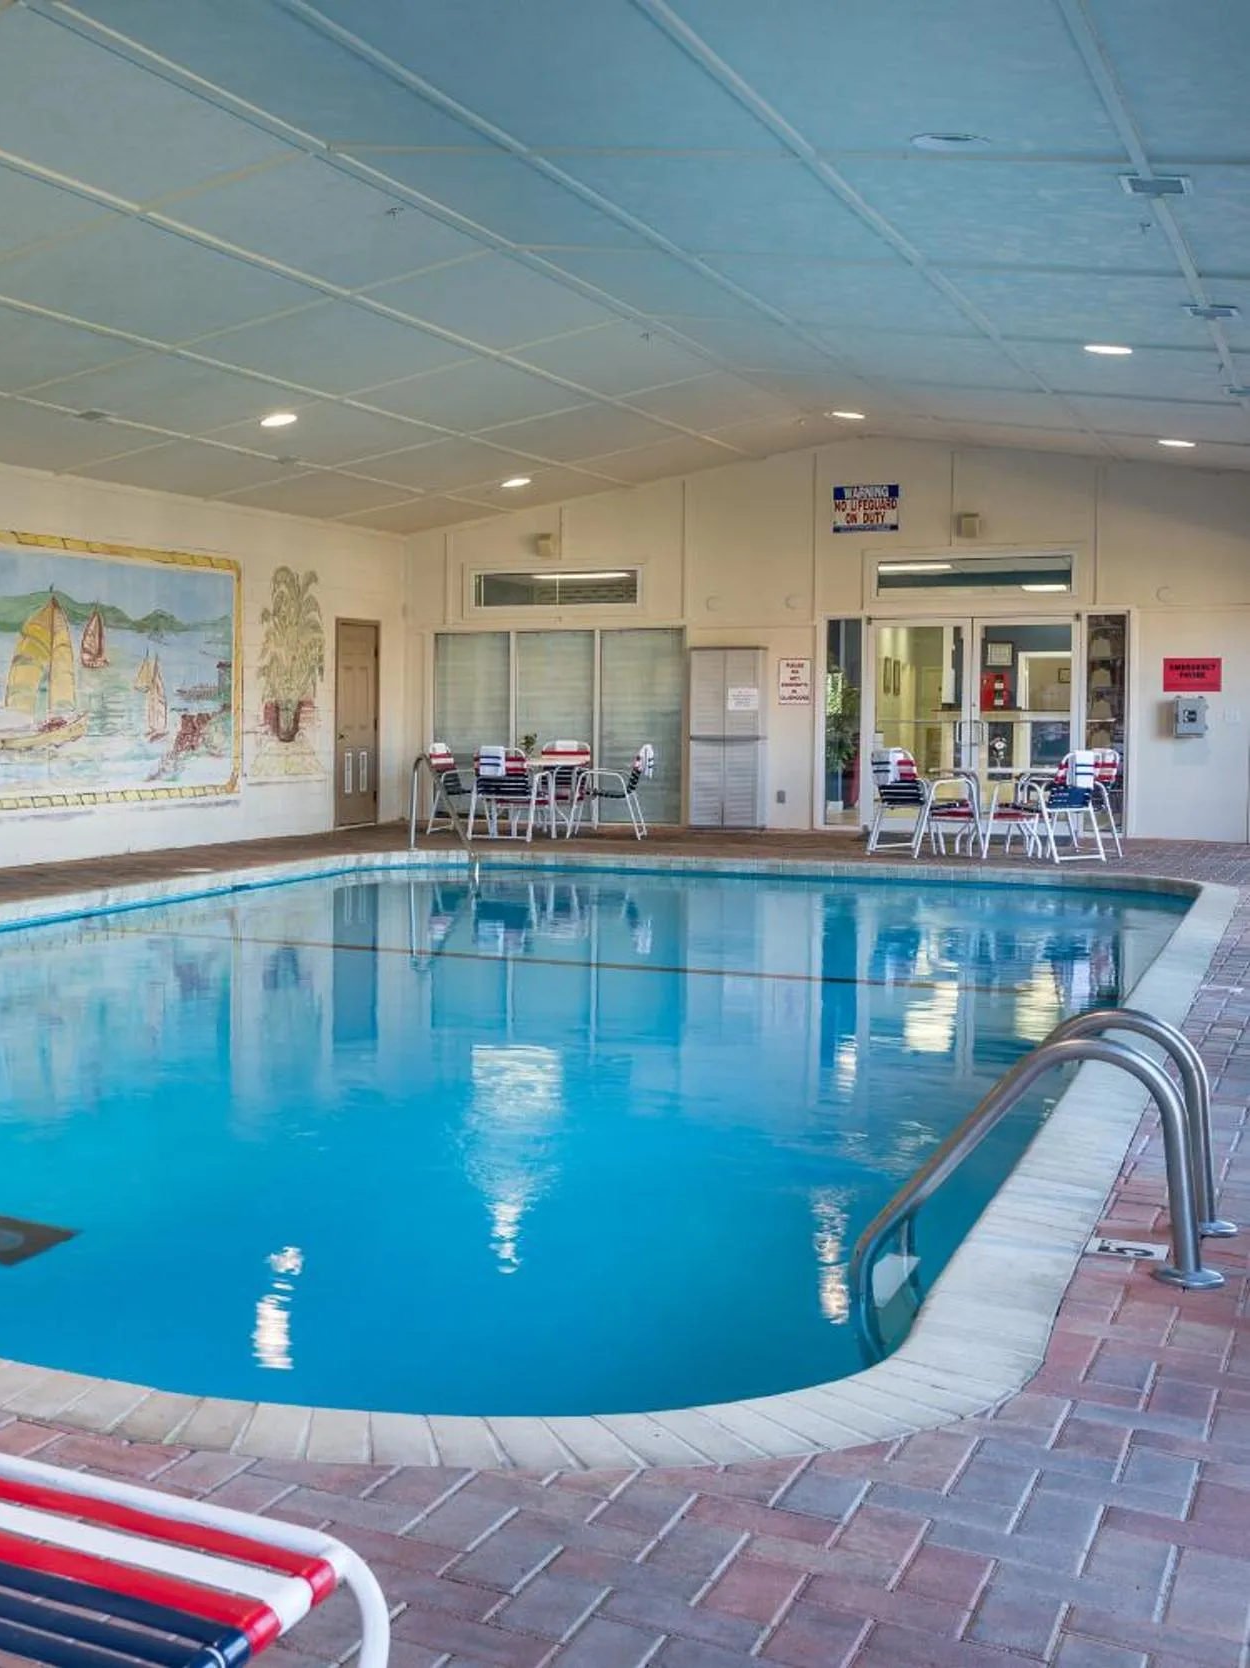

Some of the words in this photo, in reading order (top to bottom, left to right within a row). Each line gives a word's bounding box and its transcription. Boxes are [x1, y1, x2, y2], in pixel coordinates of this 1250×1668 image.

[844, 485, 889, 499] WARNING
[834, 500, 847, 512] NO
[851, 498, 898, 512] LIFEGUARD
[846, 512, 857, 524] ON
[863, 511, 886, 524] DUTY
[1169, 663, 1216, 671] EMERGENCY
